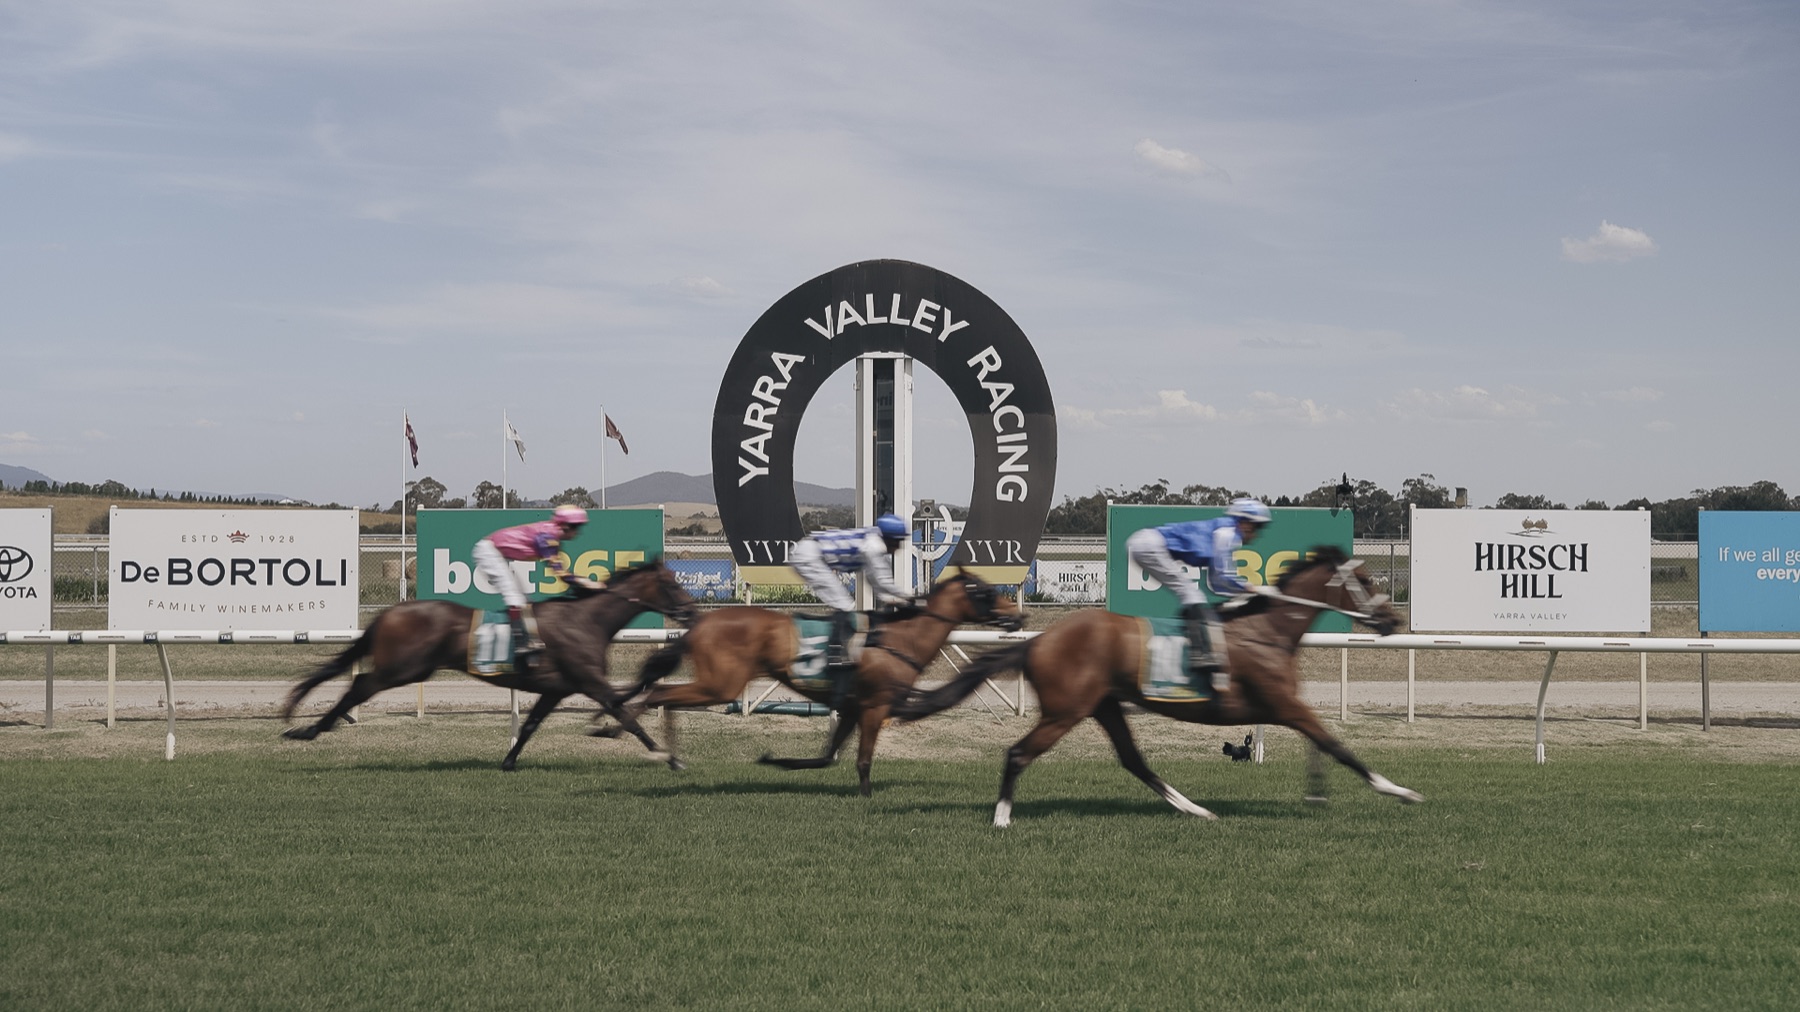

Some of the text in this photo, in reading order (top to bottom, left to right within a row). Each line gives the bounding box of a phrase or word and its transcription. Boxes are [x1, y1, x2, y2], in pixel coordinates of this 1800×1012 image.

[738, 293, 1029, 503] YARRA VALLEY RACING
[181, 535, 296, 543] ESTD 1928
[965, 540, 1027, 563] YVR
[1475, 542, 1589, 572] HIRSCH
[1719, 547, 1730, 562] If
[1733, 550, 1757, 562] we
[1762, 547, 1780, 562] all
[121, 558, 347, 586] De BORTOLI
[1501, 573, 1563, 598] HILL
[148, 600, 327, 613] FAMILY WINEMAKERS
[1493, 612, 1568, 620] YARRA VALLEY
